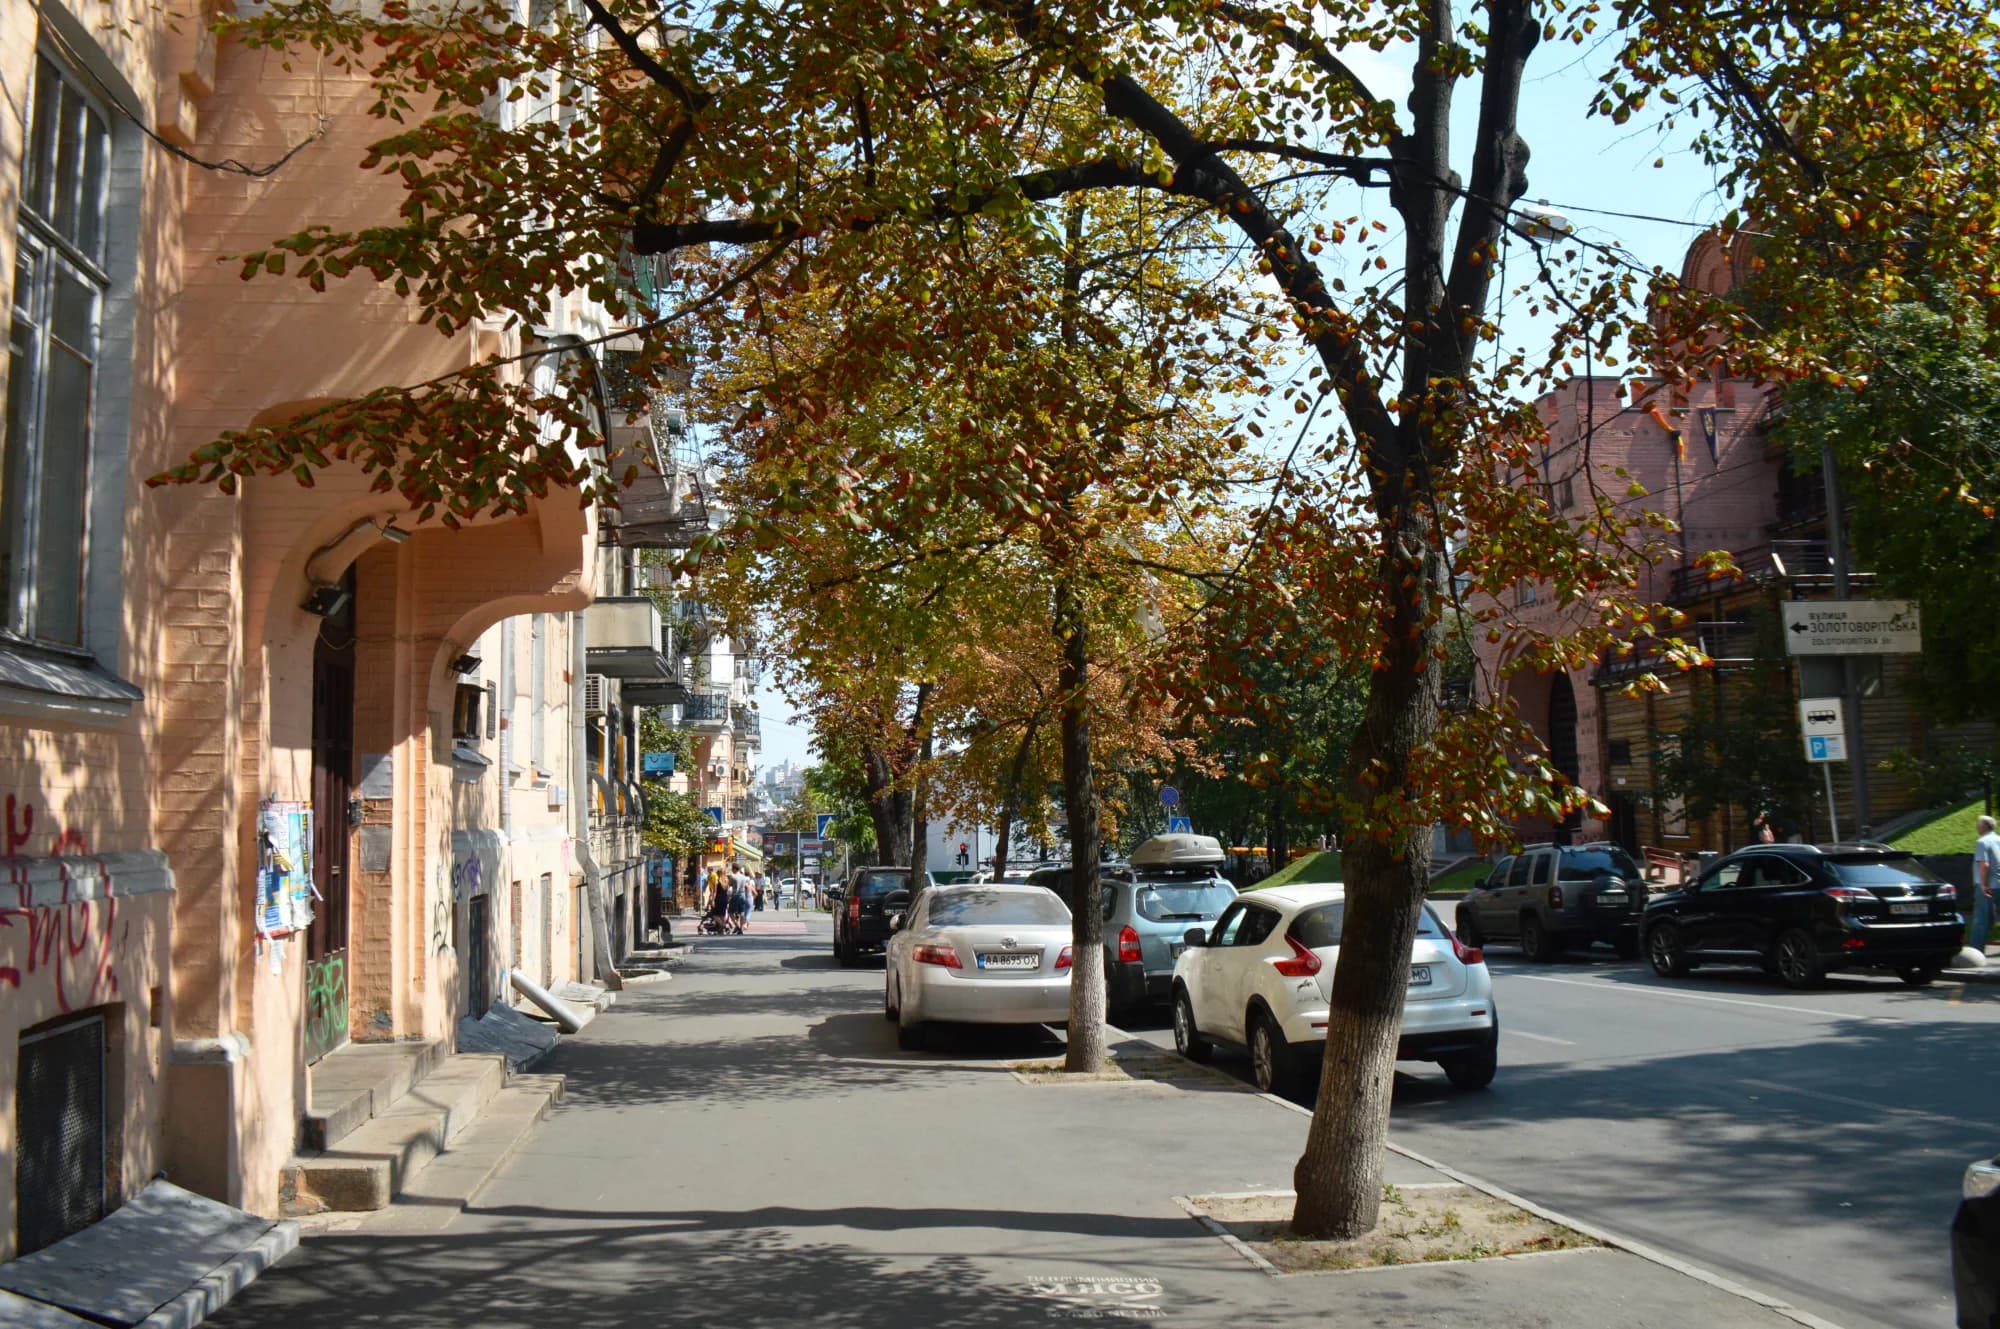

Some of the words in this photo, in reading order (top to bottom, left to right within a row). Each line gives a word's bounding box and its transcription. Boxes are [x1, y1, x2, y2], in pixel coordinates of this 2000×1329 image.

[1809, 612, 1847, 621] вулиця
[1810, 622, 1917, 632] ЗОЛОТОВОРІТСЬКА
[986, 955, 999, 966] AA
